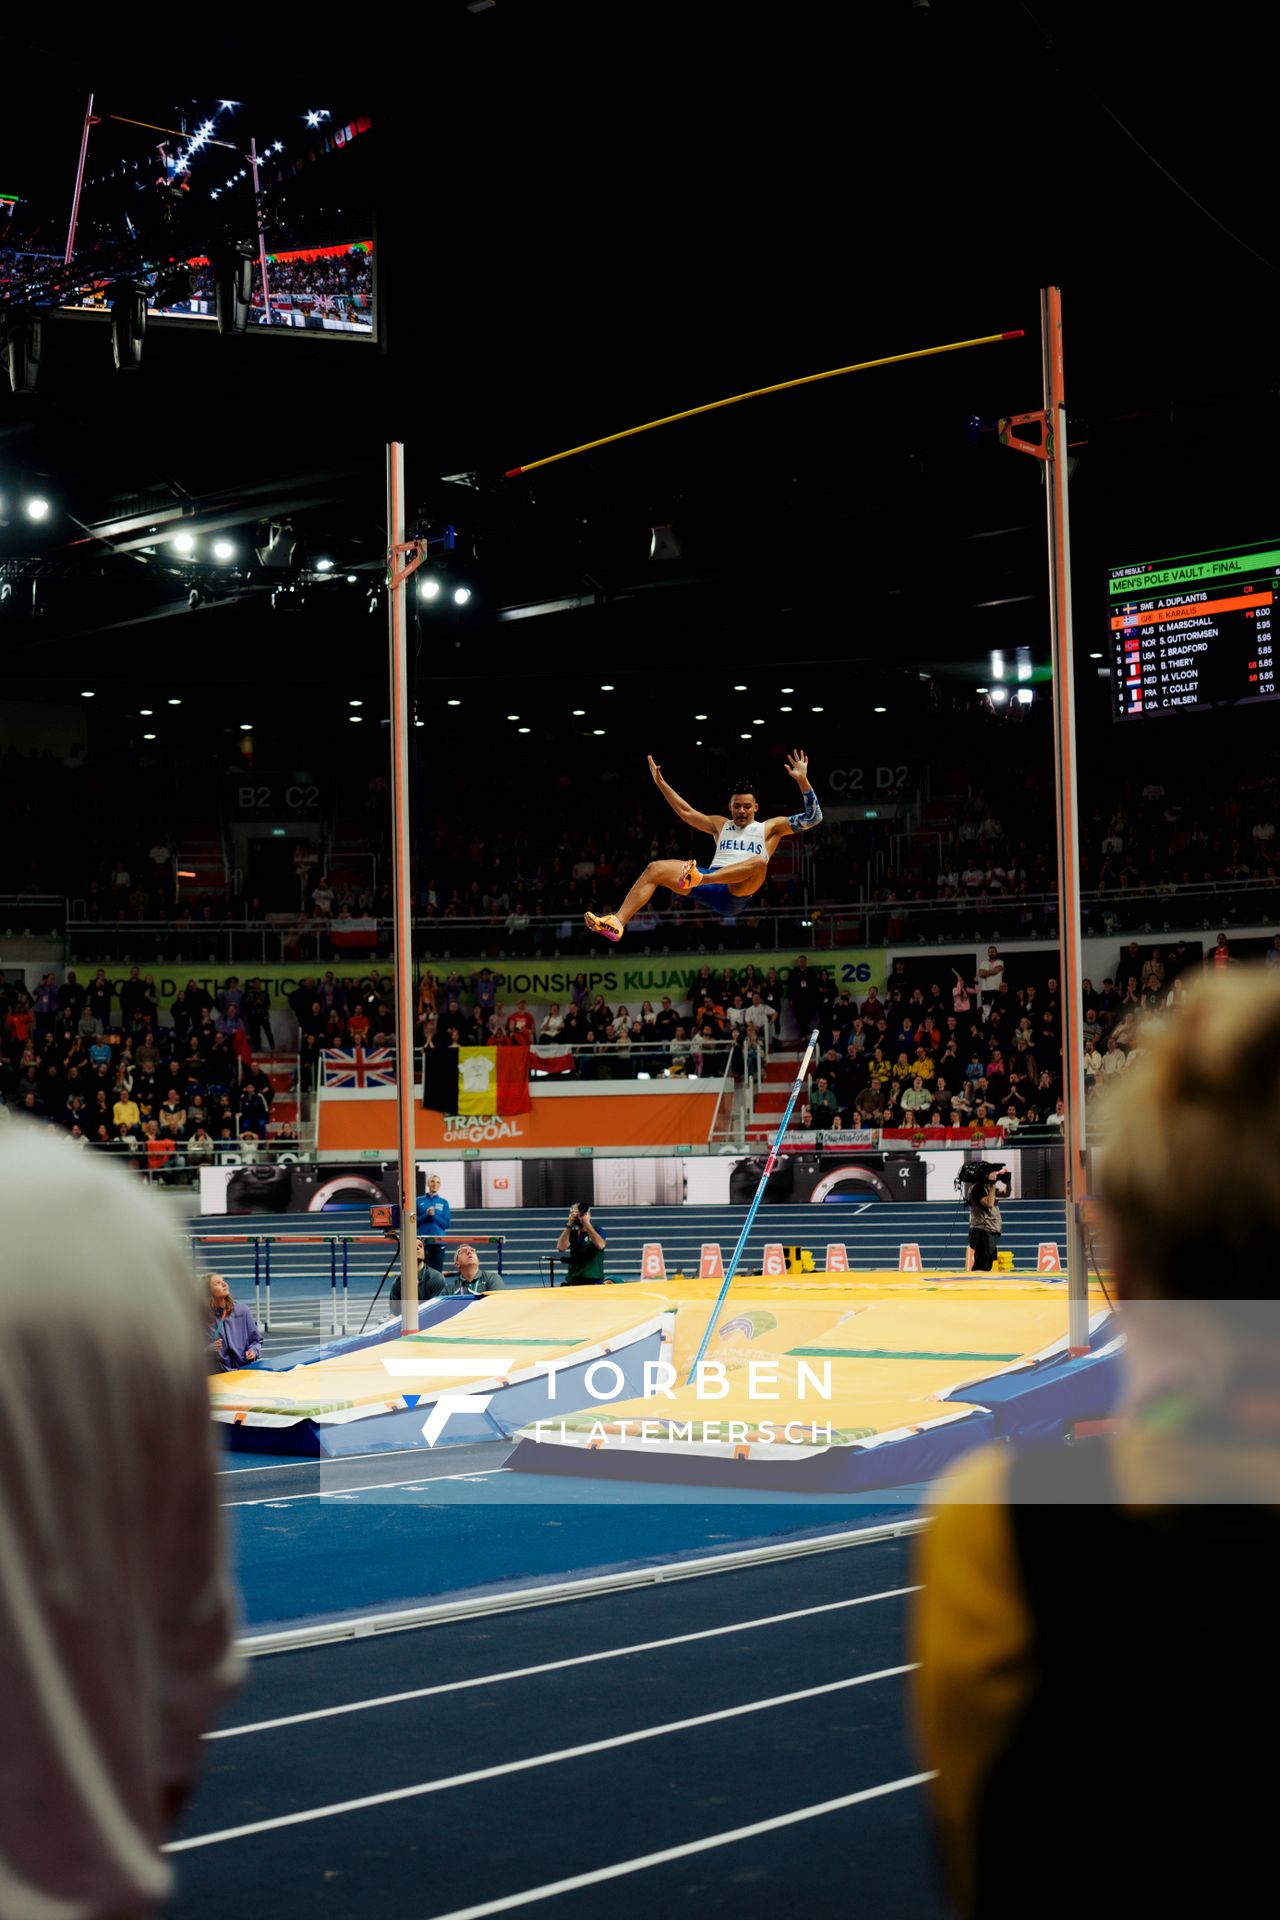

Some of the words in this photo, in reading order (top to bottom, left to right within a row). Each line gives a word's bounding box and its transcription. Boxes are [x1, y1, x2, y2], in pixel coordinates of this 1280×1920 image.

[1113, 576, 1142, 591] MEN'S
[1144, 572, 1170, 585] POLE
[1172, 567, 1203, 580] VAULT
[1213, 561, 1241, 574] FINAL
[1125, 566, 1145, 575] RESULT
[1140, 602, 1153, 611] SWE
[1158, 599, 1166, 608] A.
[1166, 593, 1207, 606] DUPLANTIS
[1141, 627, 1154, 635] AUS
[1159, 624, 1166, 632] K.
[1167, 617, 1212, 631] MARSCHALL
[1256, 608, 1270, 618] 6.00
[1166, 608, 1197, 618] KARALIS
[1142, 639, 1156, 648] NOR
[1160, 636, 1166, 645] S.
[1167, 628, 1218, 644] GUTTORMSEN
[1257, 621, 1270, 630] 5.95
[1143, 652, 1155, 660] USA
[1160, 649, 1167, 657] Z.
[1168, 643, 1208, 656] BRADFORD
[1258, 633, 1271, 642] 5.95
[1143, 664, 1156, 672] FRA
[1161, 662, 1167, 670] B.
[1168, 658, 1194, 669] THIERY
[1144, 676, 1157, 684] NED
[1162, 674, 1170, 682] M.
[1171, 670, 1198, 680] VLOON
[1145, 689, 1157, 697] FRA
[1162, 686, 1169, 694] T.
[1170, 682, 1198, 693] COLLET
[1145, 701, 1158, 709] USA
[1163, 699, 1170, 707] C.
[1171, 695, 1197, 706] NILSEN
[1260, 684, 1274, 693] 5.70
[829, 768, 864, 791] C2
[876, 766, 909, 788] D2
[239, 786, 270, 807] B2
[286, 786, 319, 807] C2
[720, 839, 762, 855] HELLAS
[841, 964, 871, 983] 26
[443, 1129, 470, 1142] ONE
[470, 1121, 524, 1142] GOAL
[647, 1255, 661, 1274] 8
[704, 1256, 718, 1274] 7
[767, 1256, 782, 1275] 6
